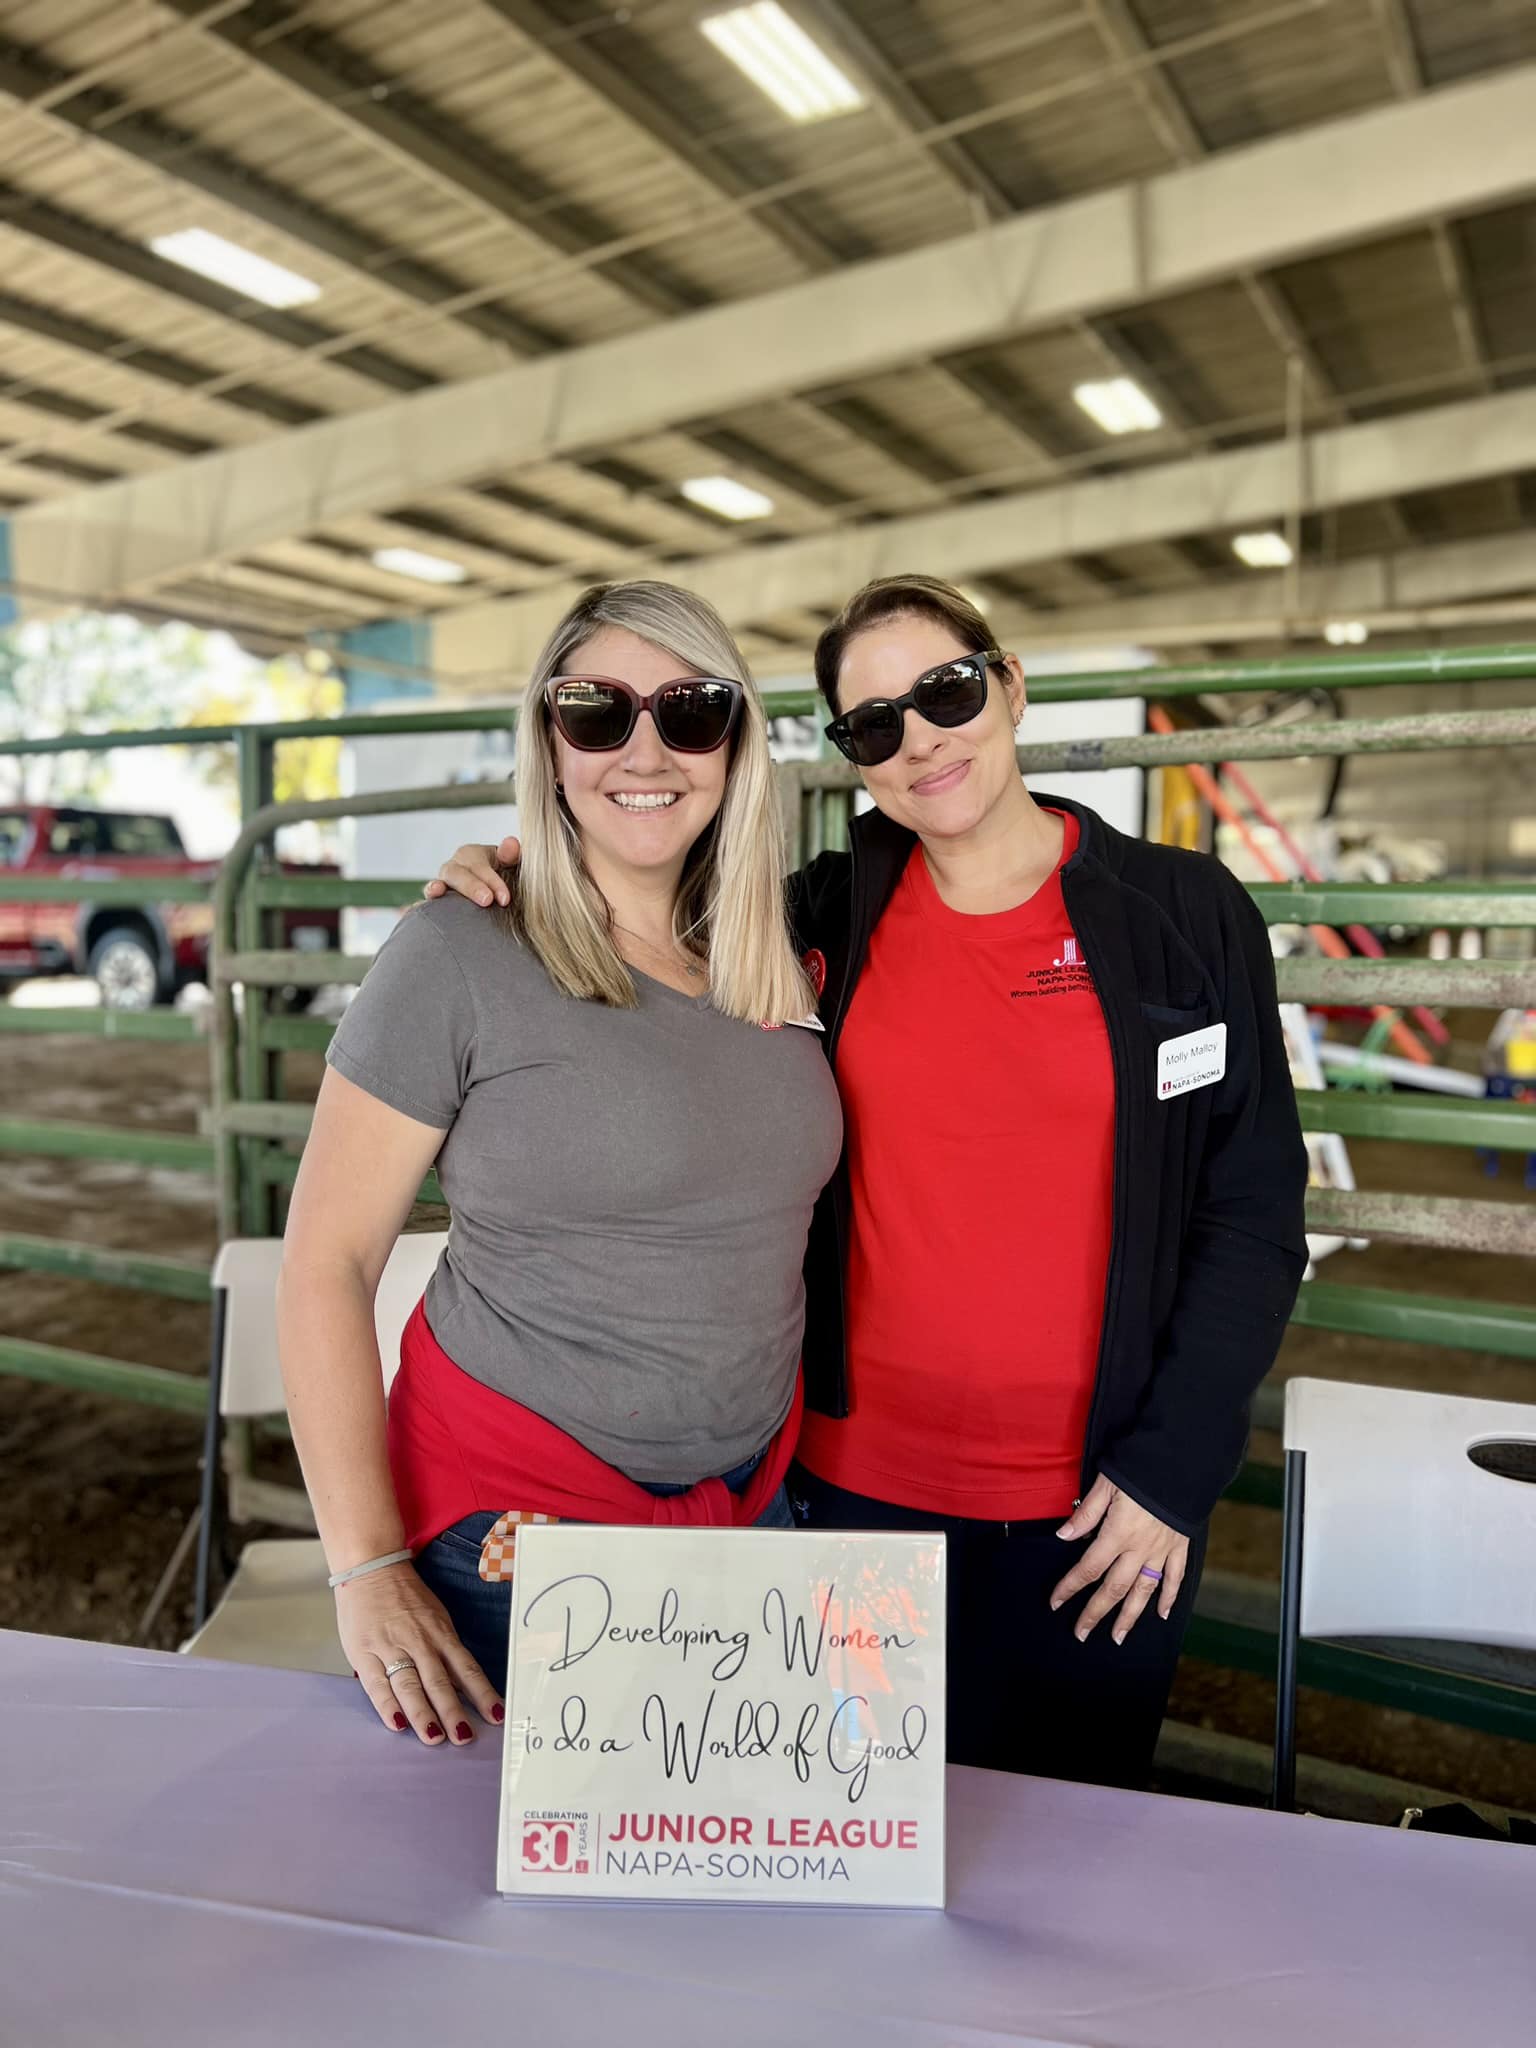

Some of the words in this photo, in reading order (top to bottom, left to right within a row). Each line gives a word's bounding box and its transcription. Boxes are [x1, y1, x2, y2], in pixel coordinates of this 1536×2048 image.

[1027, 967, 1062, 978] JUNIOR
[1010, 990, 1038, 999] Women
[1039, 985, 1066, 996] building
[1166, 1051, 1188, 1065] Molly
[1190, 1043, 1217, 1056] Malloy
[1173, 1069, 1221, 1089] NAPA-SONOMA
[523, 1574, 749, 1681] Developing
[763, 1583, 916, 1677] Women
[519, 1715, 544, 1755] to
[553, 1695, 590, 1752] do
[599, 1738, 634, 1754] a
[643, 1689, 780, 1785] World
[783, 1703, 820, 1784] of
[827, 1695, 928, 1804] Good
[523, 1810, 589, 1821] CELEBRATING
[608, 1813, 753, 1846] JUNIOR
[767, 1817, 918, 1849] LEAGUE
[521, 1821, 575, 1873] 30
[578, 1821, 588, 1857] YEARS
[605, 1850, 850, 1881] NAPA-SONOMA
